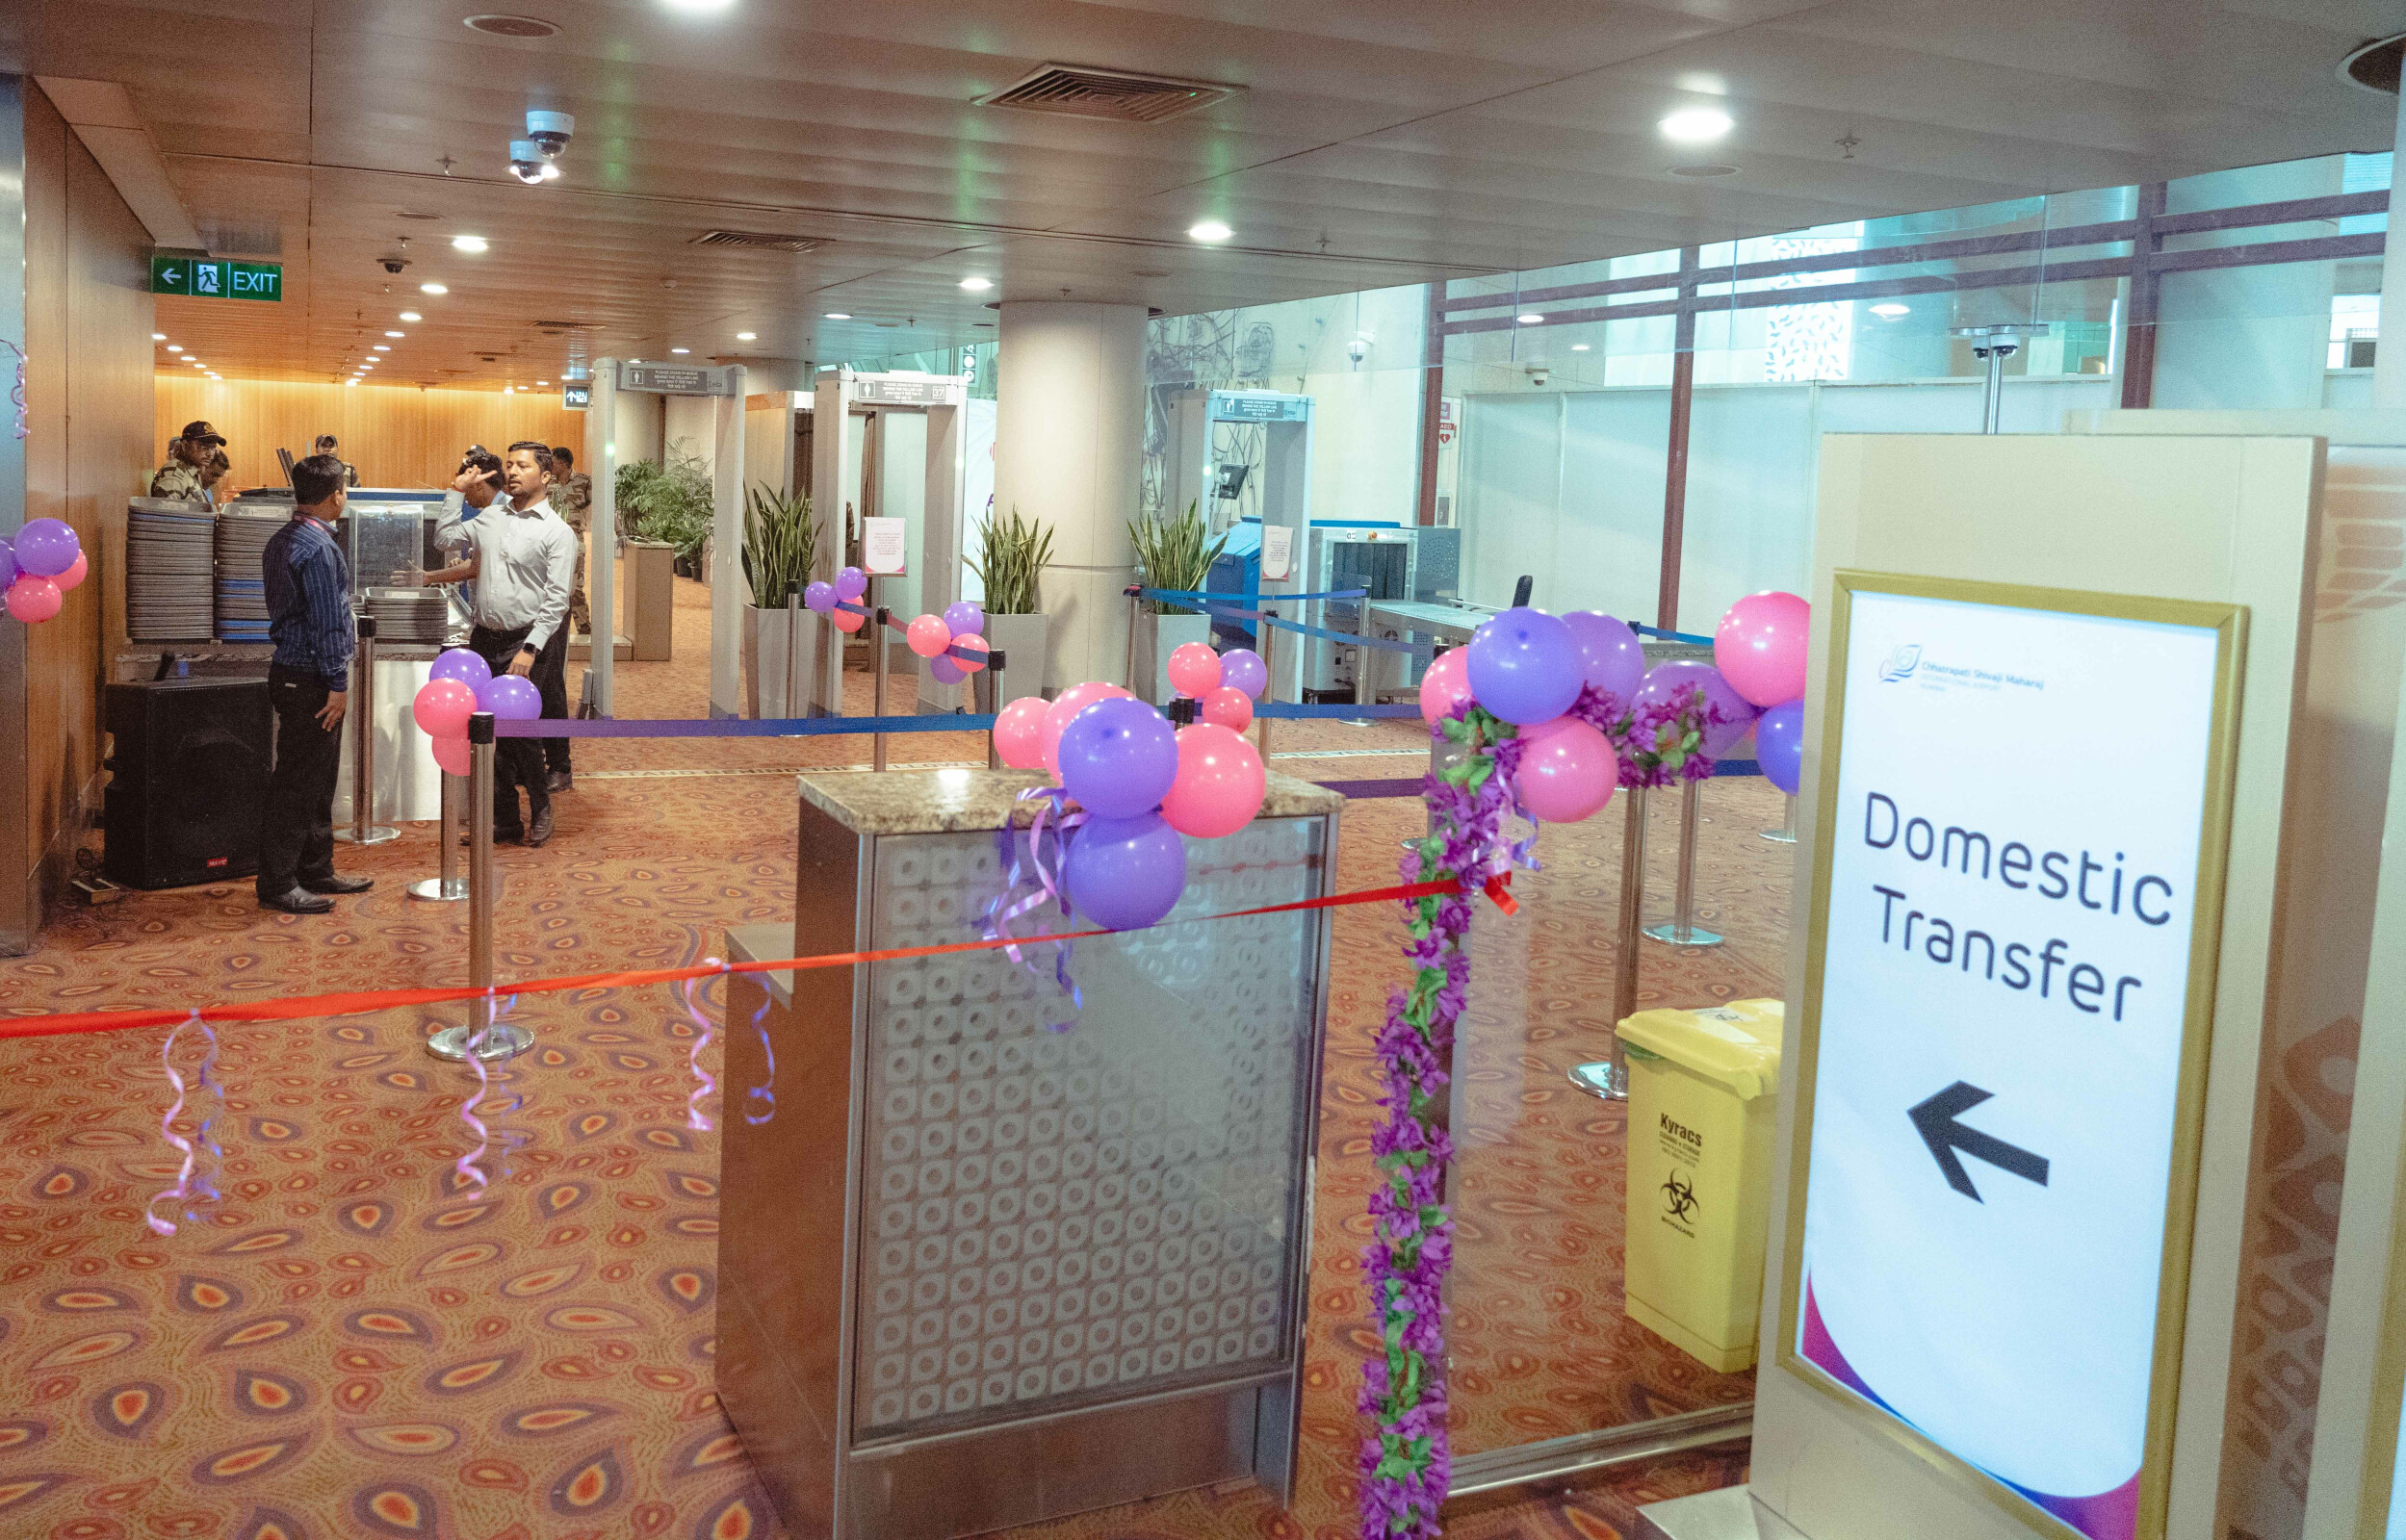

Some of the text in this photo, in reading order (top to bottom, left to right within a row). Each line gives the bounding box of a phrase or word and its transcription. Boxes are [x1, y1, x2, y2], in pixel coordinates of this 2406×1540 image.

[233, 270, 278, 293] EXIT
[933, 389, 944, 398] 37
[1922, 661, 2044, 690] Chhatrapati Shivaji Maharaj
[1864, 790, 2173, 927] Domestic
[1872, 884, 2143, 1022] Transfer
[1660, 1112, 1702, 1147] Kyracs
[1661, 1215, 1695, 1239] BIOHAZARD
